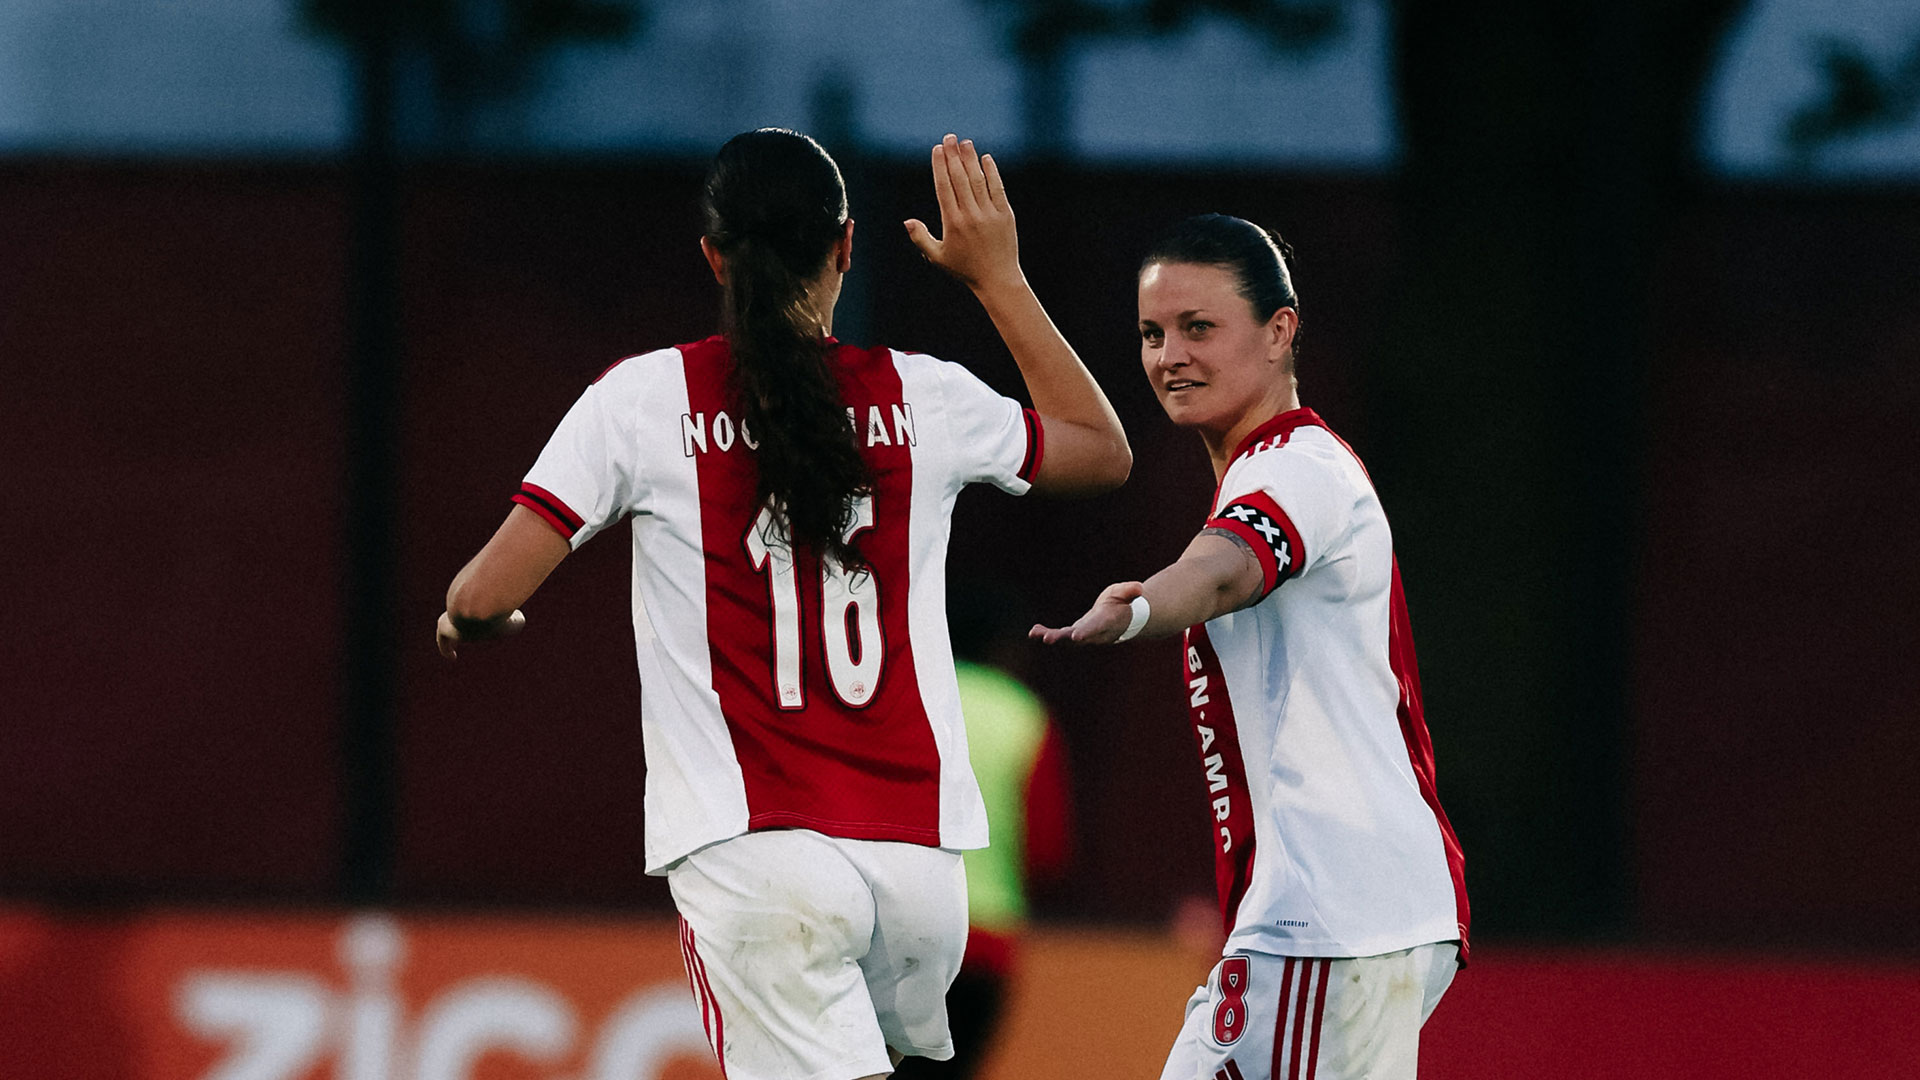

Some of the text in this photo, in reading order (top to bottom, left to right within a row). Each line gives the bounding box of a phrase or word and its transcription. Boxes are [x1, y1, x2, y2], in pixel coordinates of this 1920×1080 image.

[681, 402, 916, 457] NOAN
[742, 490, 887, 711] 16
[1212, 955, 1250, 1046] 8
